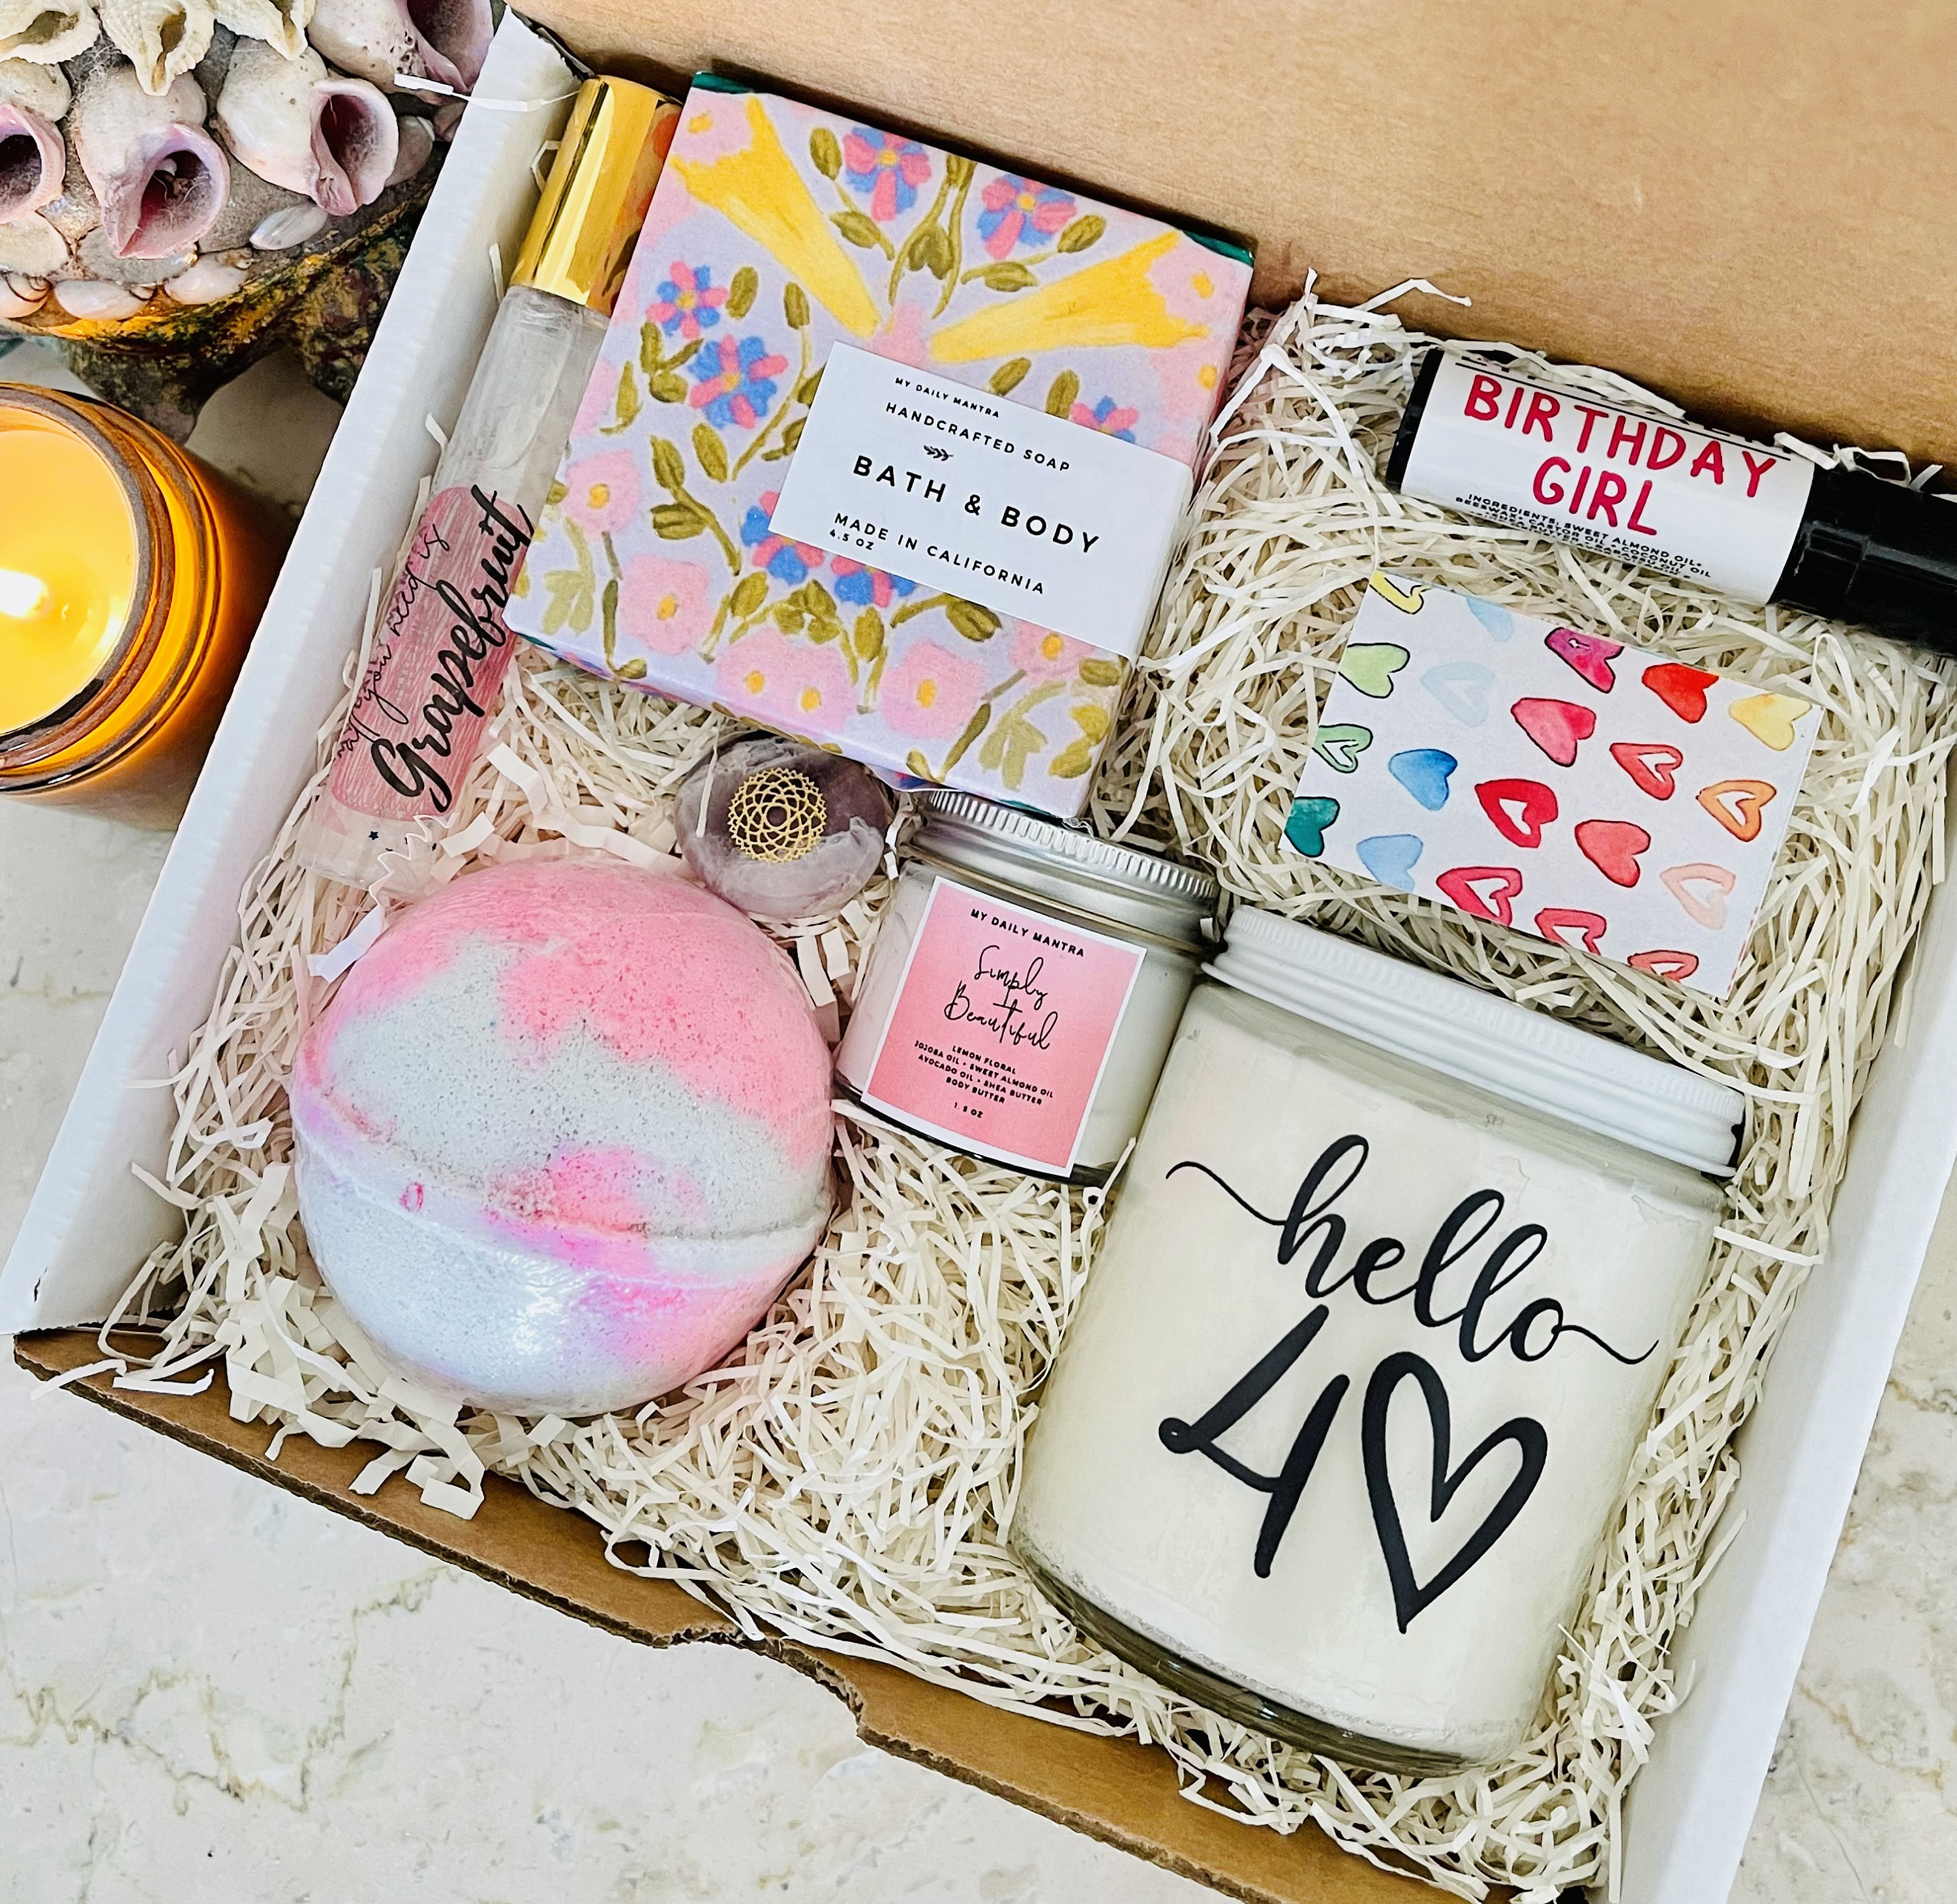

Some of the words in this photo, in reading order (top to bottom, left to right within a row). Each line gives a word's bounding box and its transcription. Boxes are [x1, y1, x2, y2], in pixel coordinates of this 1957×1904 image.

[895, 377, 911, 387] MY
[916, 384, 948, 400] DAILY
[953, 397, 999, 418] MANTRA
[885, 402, 1015, 454] HANDCRAFTED
[1024, 449, 1070, 472] SOAP
[1464, 374, 1777, 498] BIRTHDAY
[853, 455, 947, 503] BATH
[964, 494, 982, 516] &
[1000, 506, 1100, 554] BODY
[1532, 456, 1658, 536] GIRL
[829, 528, 850, 543] 4.5
[856, 539, 875, 551] OZ
[834, 512, 888, 541] MADE
[898, 534, 917, 551] IN
[927, 545, 1044, 595] CALIFORNIA
[1528, 519, 1580, 538] CASTOR
[1585, 536, 1605, 546] OIL
[1622, 547, 1686, 569] COCONUT
[1690, 567, 1711, 578] OIL
[1564, 522, 1609, 540] SWEET
[1612, 537, 1669, 558] ALMOND
[371, 484, 534, 813] Grapefruit
[364, 644, 409, 725] you
[971, 909, 988, 922] MY
[992, 916, 1029, 937] DAILY
[1033, 932, 1085, 958] MANTRA
[974, 944, 1048, 1010] Simply
[944, 980, 1058, 1050] Beautiful
[914, 1040, 944, 1058] JOJOBA
[946, 1054, 960, 1065] OIL
[969, 1063, 999, 1079] SWEET
[1001, 1076, 1038, 1093] ALMOND
[1040, 1089, 1054, 1098] OIL
[918, 1054, 958, 1074] AVOCADO
[960, 1071, 973, 1081] OIL
[983, 1080, 1007, 1093] SHEA
[1009, 1089, 1042, 1106] BUTTER
[945, 1076, 970, 1090] BODY
[971, 1086, 1005, 1104] BUTTER
[952, 1045, 982, 1062] LEMON
[984, 1057, 1016, 1075] FLORAL
[970, 1109, 984, 1119] OZ
[1166, 1134, 1660, 1365] hello
